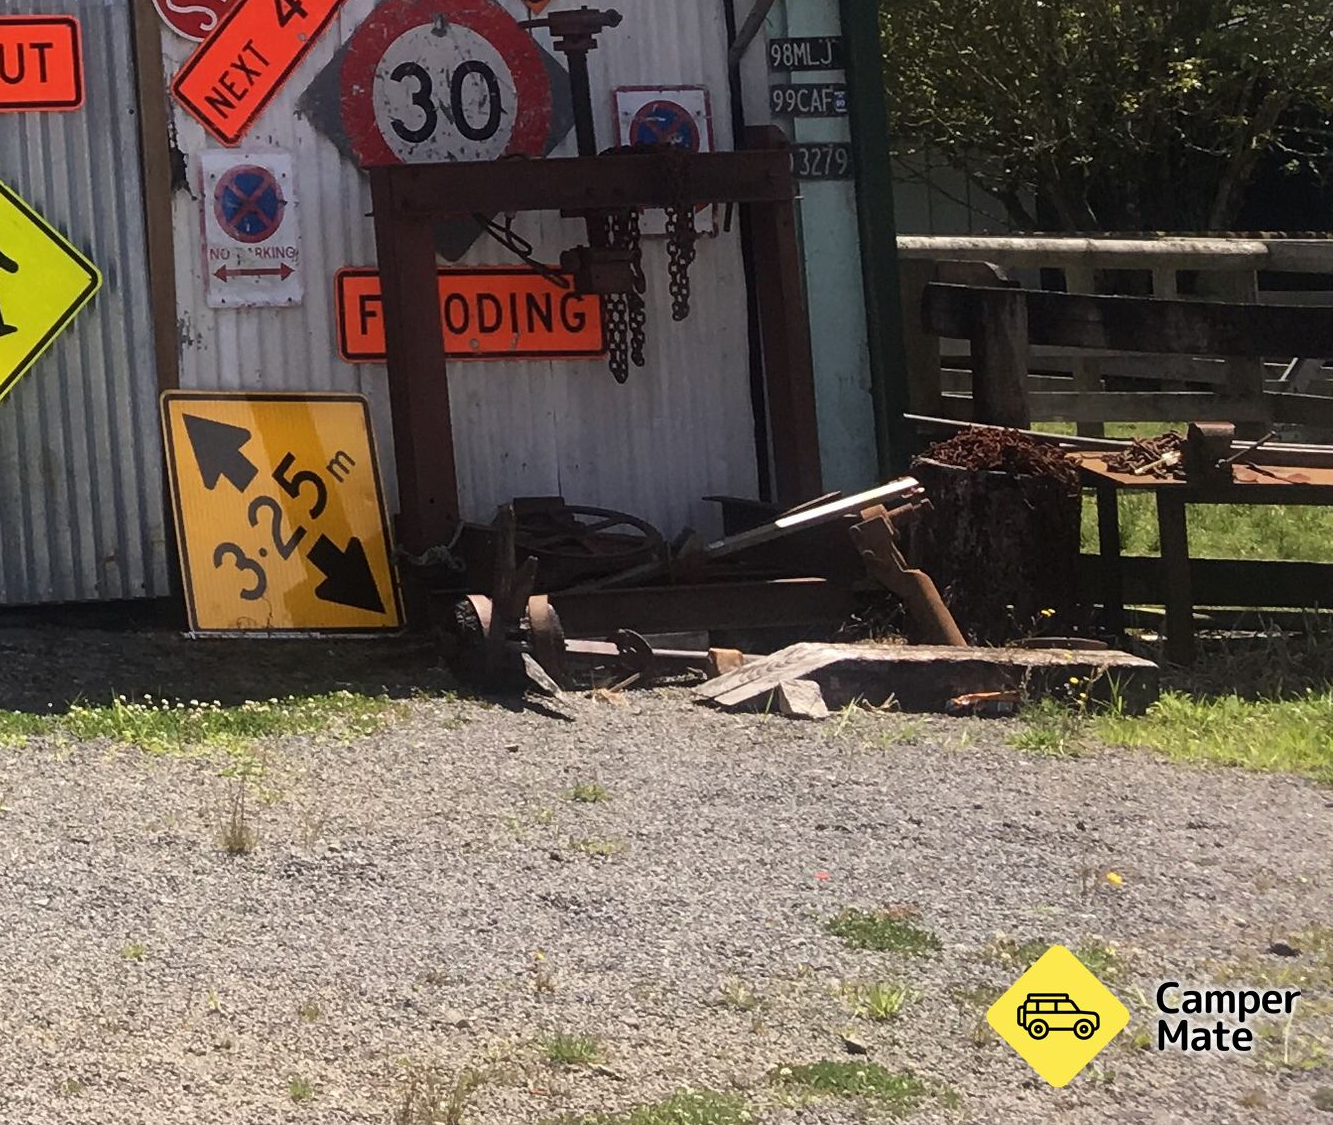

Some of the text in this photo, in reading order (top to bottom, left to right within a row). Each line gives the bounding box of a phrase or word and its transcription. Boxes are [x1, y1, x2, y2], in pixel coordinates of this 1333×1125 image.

[771, 40, 833, 66] 98MLJ
[204, 39, 270, 119] NEXT
[389, 59, 503, 143] 30
[789, 148, 848, 175] 3279
[209, 248, 230, 260] NO
[235, 246, 297, 260] RKING
[359, 291, 586, 335] FODING
